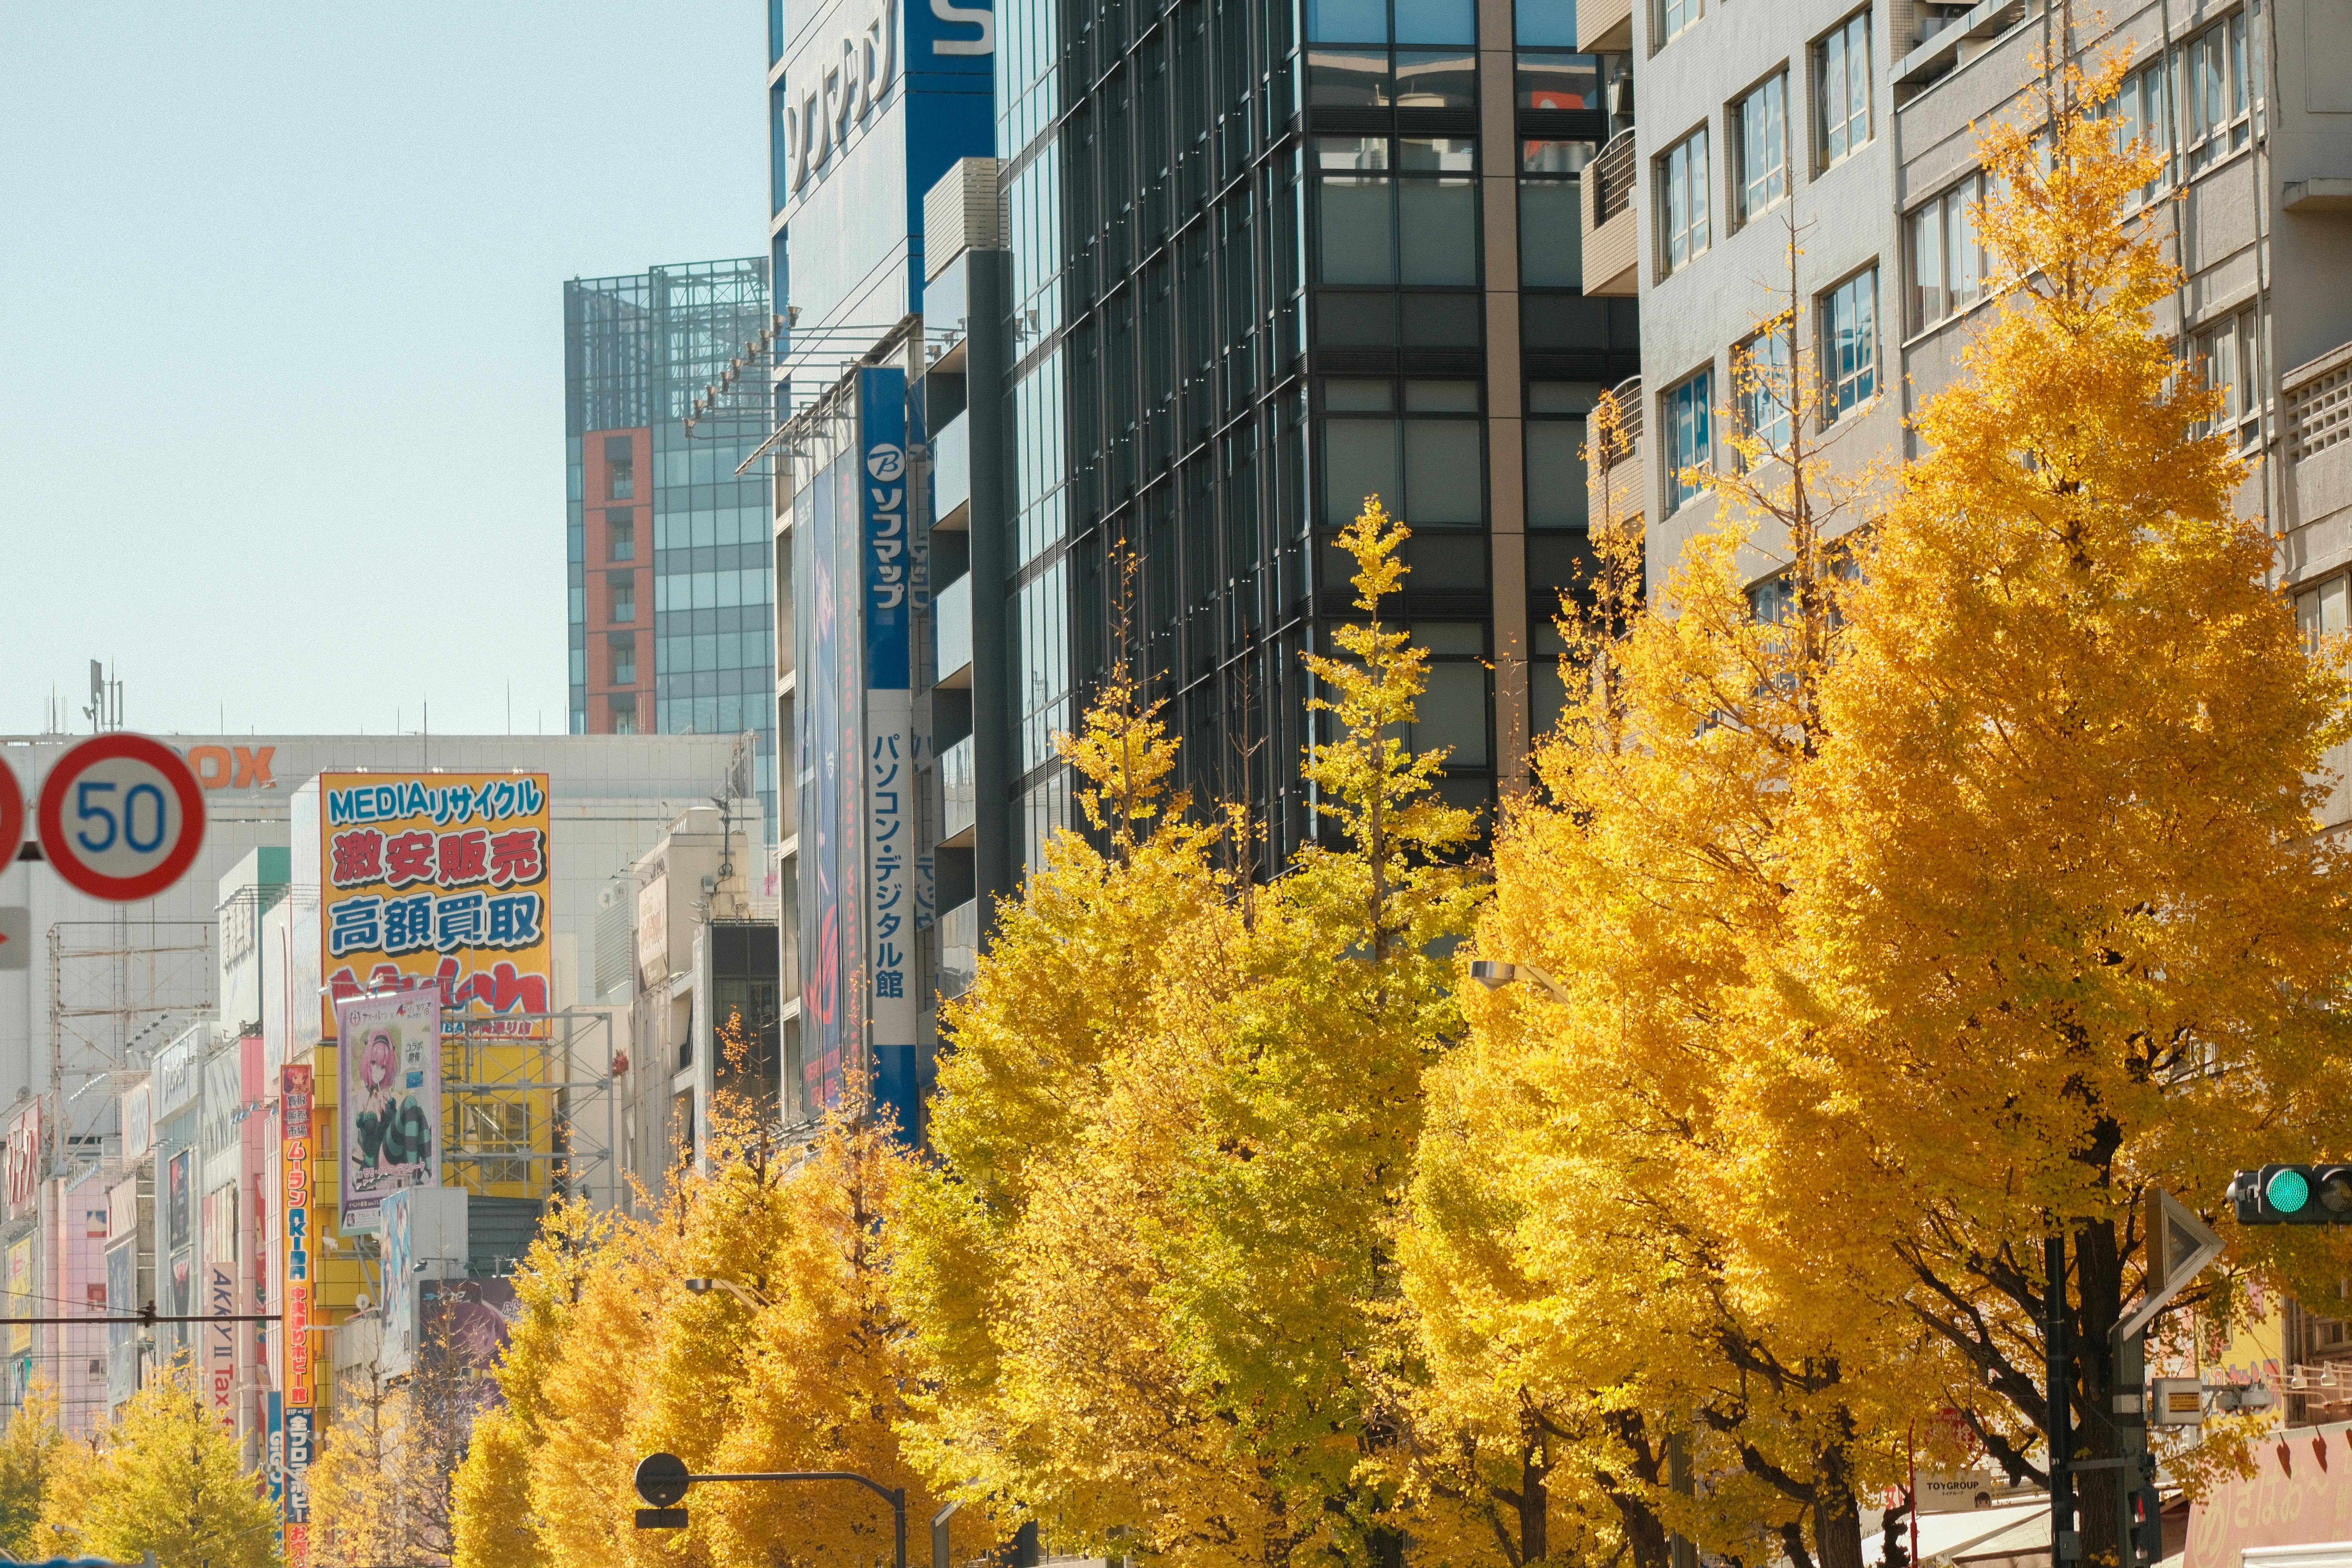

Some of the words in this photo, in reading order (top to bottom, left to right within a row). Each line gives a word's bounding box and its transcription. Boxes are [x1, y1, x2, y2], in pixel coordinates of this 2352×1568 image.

[871, 488, 904, 609] ソフマップ
[173, 746, 277, 789] OX
[78, 781, 167, 854] 50
[329, 778, 543, 825] MEDIAリサイクル
[331, 828, 541, 886] 激安販売
[872, 733, 904, 998] パソコン・デジタル館
[329, 891, 541, 955] 高額買取
[406, 1041, 423, 1052] コラボ
[288, 1095, 307, 1108] 買取
[288, 1110, 307, 1124] 販売
[288, 1125, 308, 1138] 市場
[215, 1363, 233, 1407] Tax
[1926, 1482, 1979, 1490] TOYGROUP
